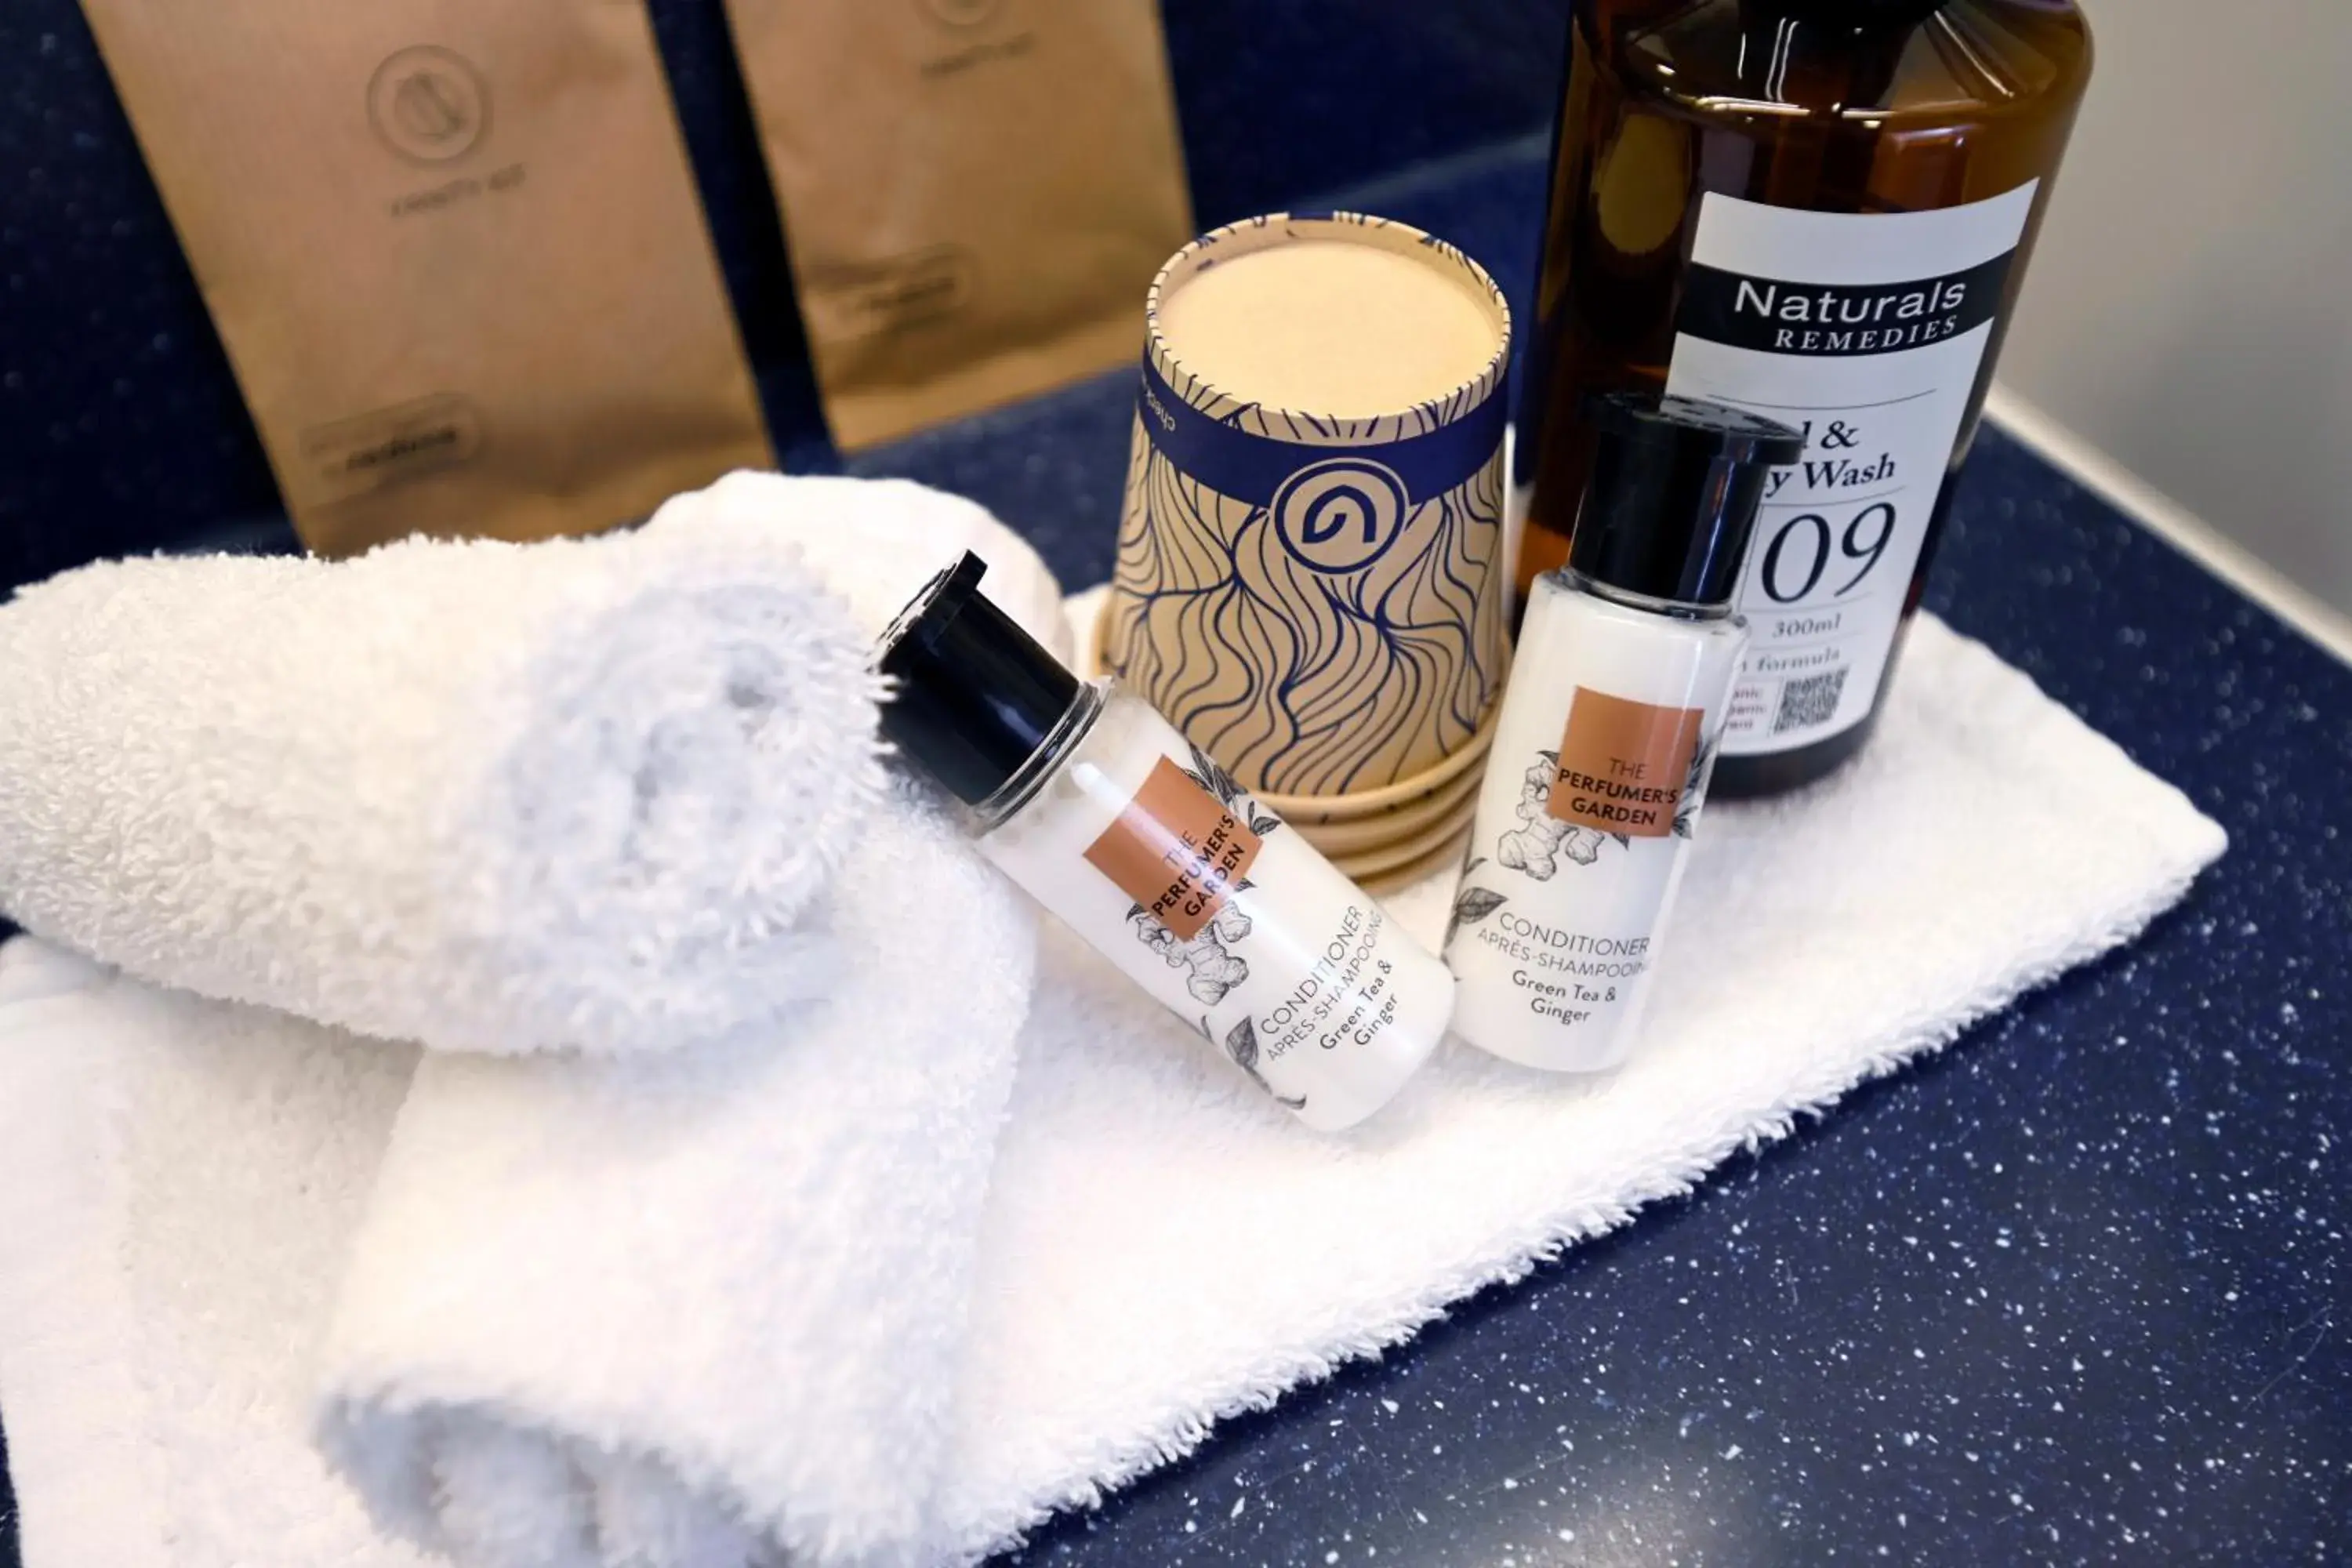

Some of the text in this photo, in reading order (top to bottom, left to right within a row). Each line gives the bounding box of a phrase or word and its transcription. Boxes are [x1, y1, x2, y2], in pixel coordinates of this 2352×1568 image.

[1734, 279, 1966, 324] Naturals
[1774, 315, 1958, 350] REMEDIES
[1820, 419, 1860, 450] &
[1802, 452, 1896, 490] Wash
[1761, 501, 1896, 604] 09
[1772, 612, 1842, 639] 300ml
[1558, 768, 1679, 804] PERFUMER'S
[1610, 757, 1648, 780] THE
[1571, 796, 1657, 826] GARDEN
[1151, 814, 1236, 917] PERFUMER'S
[1162, 829, 1198, 867] THE
[1183, 842, 1246, 916] GARDEN
[1499, 911, 1651, 956] CONDITIONER
[1260, 905, 1363, 1035] CONDITIONER
[1512, 969, 1617, 1003] Green Tea &
[1319, 959, 1393, 1051] Green Tea &
[1353, 993, 1399, 1046] Ginger
[1530, 996, 1592, 1026] Ginger
